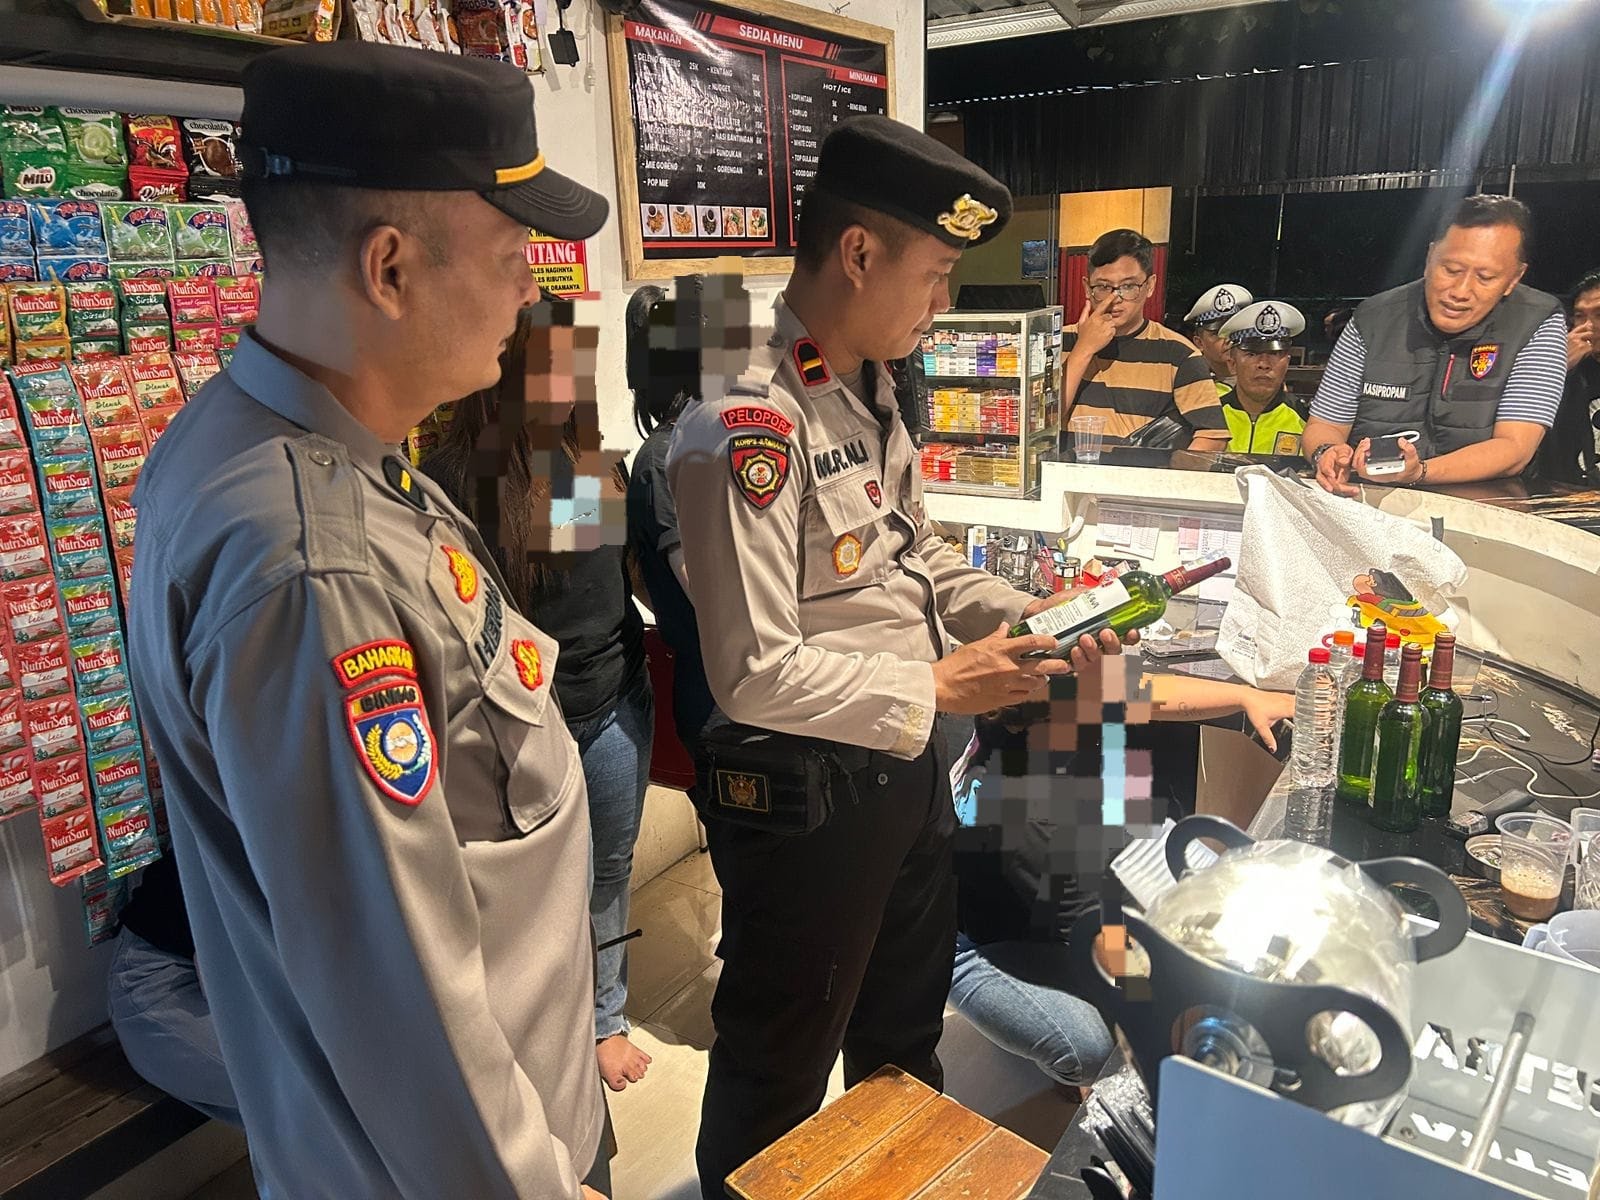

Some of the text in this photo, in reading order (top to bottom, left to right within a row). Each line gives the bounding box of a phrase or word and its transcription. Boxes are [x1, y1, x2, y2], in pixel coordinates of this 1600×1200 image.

[635, 25, 682, 45] MAKANAN
[739, 24, 803, 50] SEDIA MENU
[848, 70, 878, 84] MINUMAN
[23, 173, 53, 186] MILO
[647, 178, 659, 187] POP
[659, 179, 669, 188] MIE
[522, 242, 577, 265] UTANG
[1363, 382, 1407, 399] KASIPROPAM
[727, 408, 788, 433] PELOPOR
